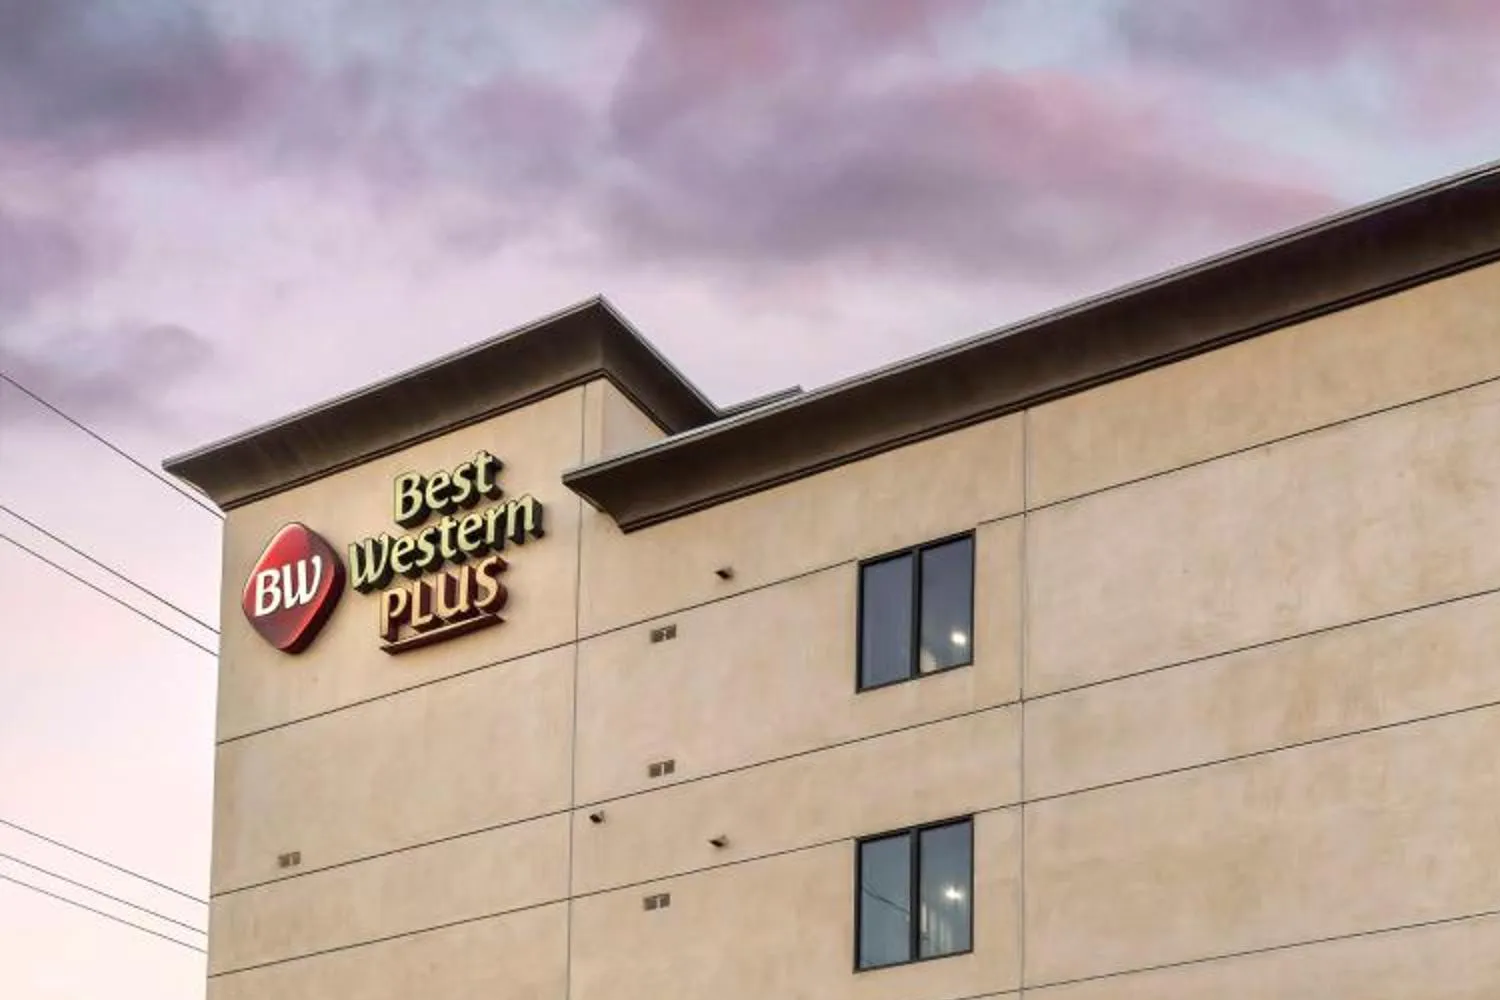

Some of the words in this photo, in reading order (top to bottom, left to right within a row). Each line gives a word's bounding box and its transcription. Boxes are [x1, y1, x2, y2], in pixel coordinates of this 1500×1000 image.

[393, 450, 501, 527] Best
[349, 494, 543, 592] Western
[254, 555, 322, 618] BW
[380, 555, 505, 641] PLUS
